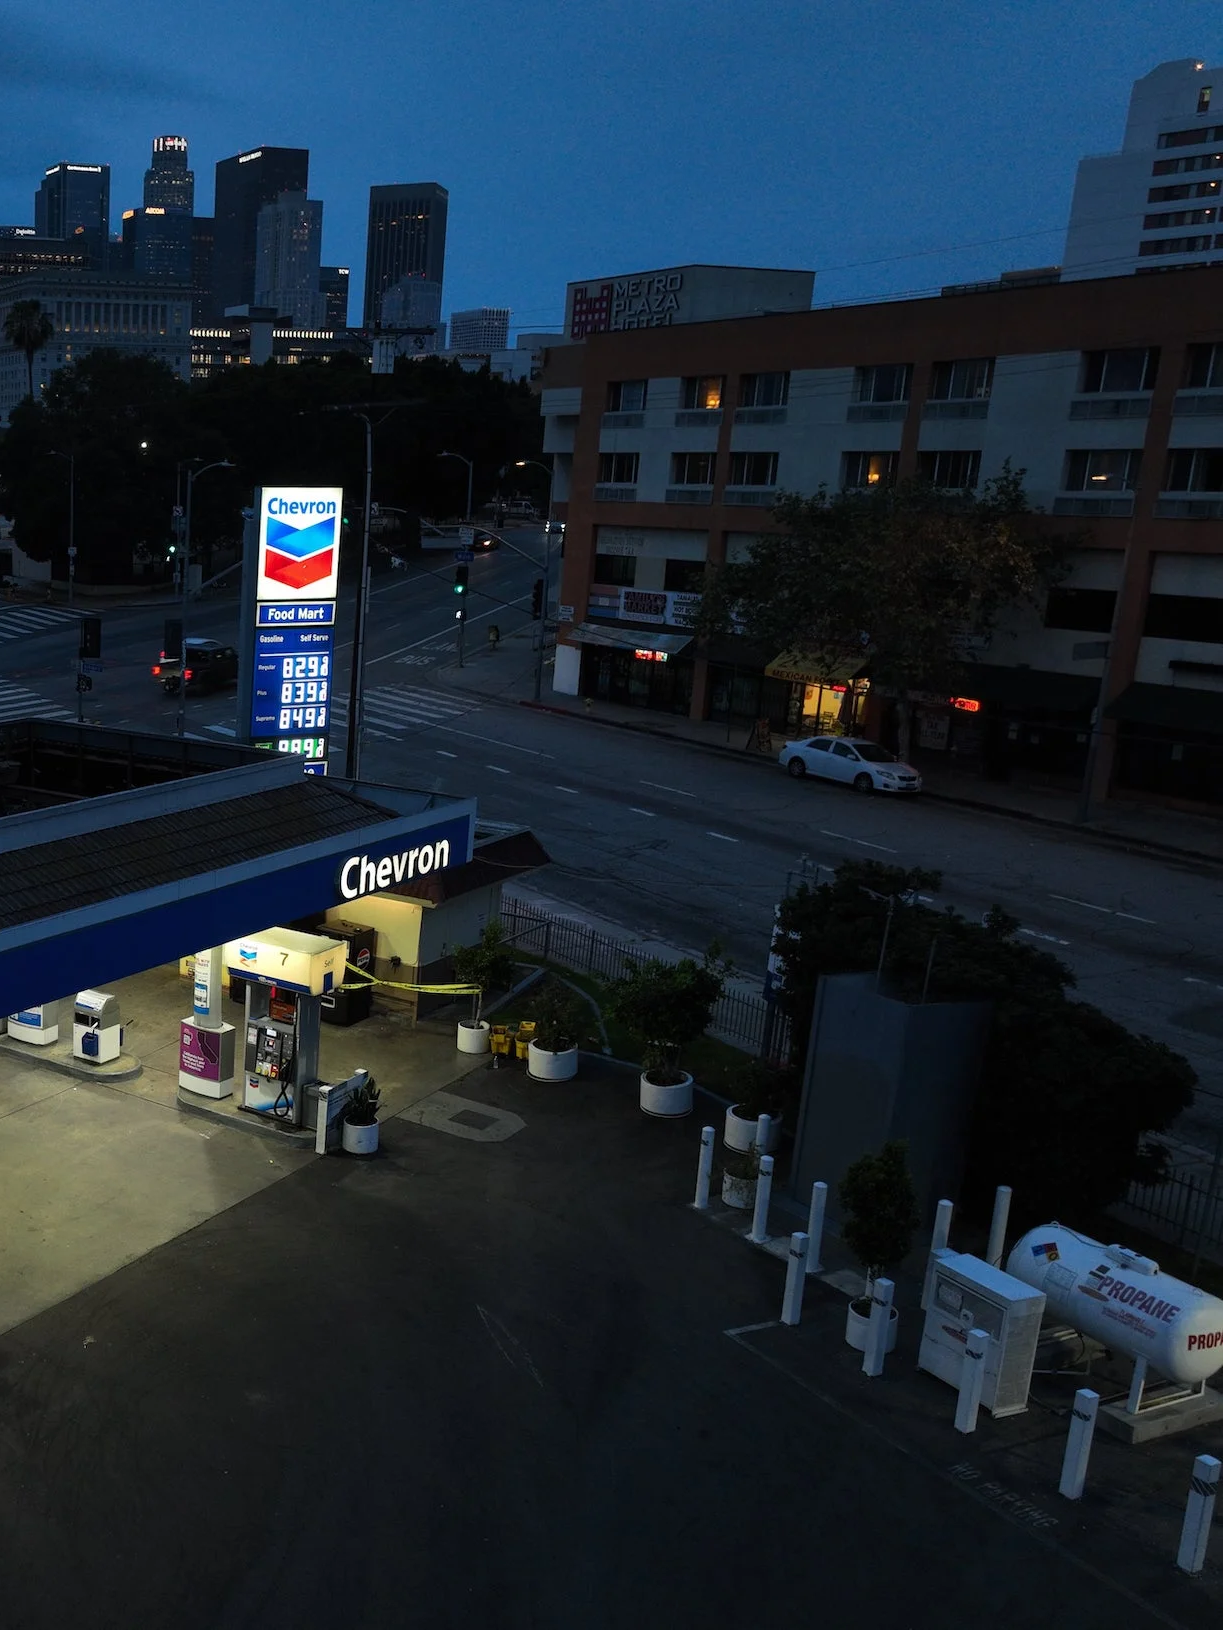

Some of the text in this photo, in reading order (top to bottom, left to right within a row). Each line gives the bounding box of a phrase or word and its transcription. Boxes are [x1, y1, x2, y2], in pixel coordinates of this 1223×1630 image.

[616, 273, 683, 298] METRO
[613, 293, 680, 317] PLAZA
[267, 497, 336, 515] Chevron
[268, 607, 324, 620] Food Mart
[624, 600, 663, 614] MARKET
[260, 635, 284, 643] Gasoline
[300, 634, 312, 642] Self
[282, 656, 318, 678] 829
[772, 668, 812, 681] MEXICAN
[281, 681, 318, 704] 839
[279, 708, 316, 729] 849
[340, 838, 450, 899] Chevron
[279, 951, 289, 966] 7
[1096, 1275, 1181, 1324] PROPANE
[948, 1462, 981, 1480] NO
